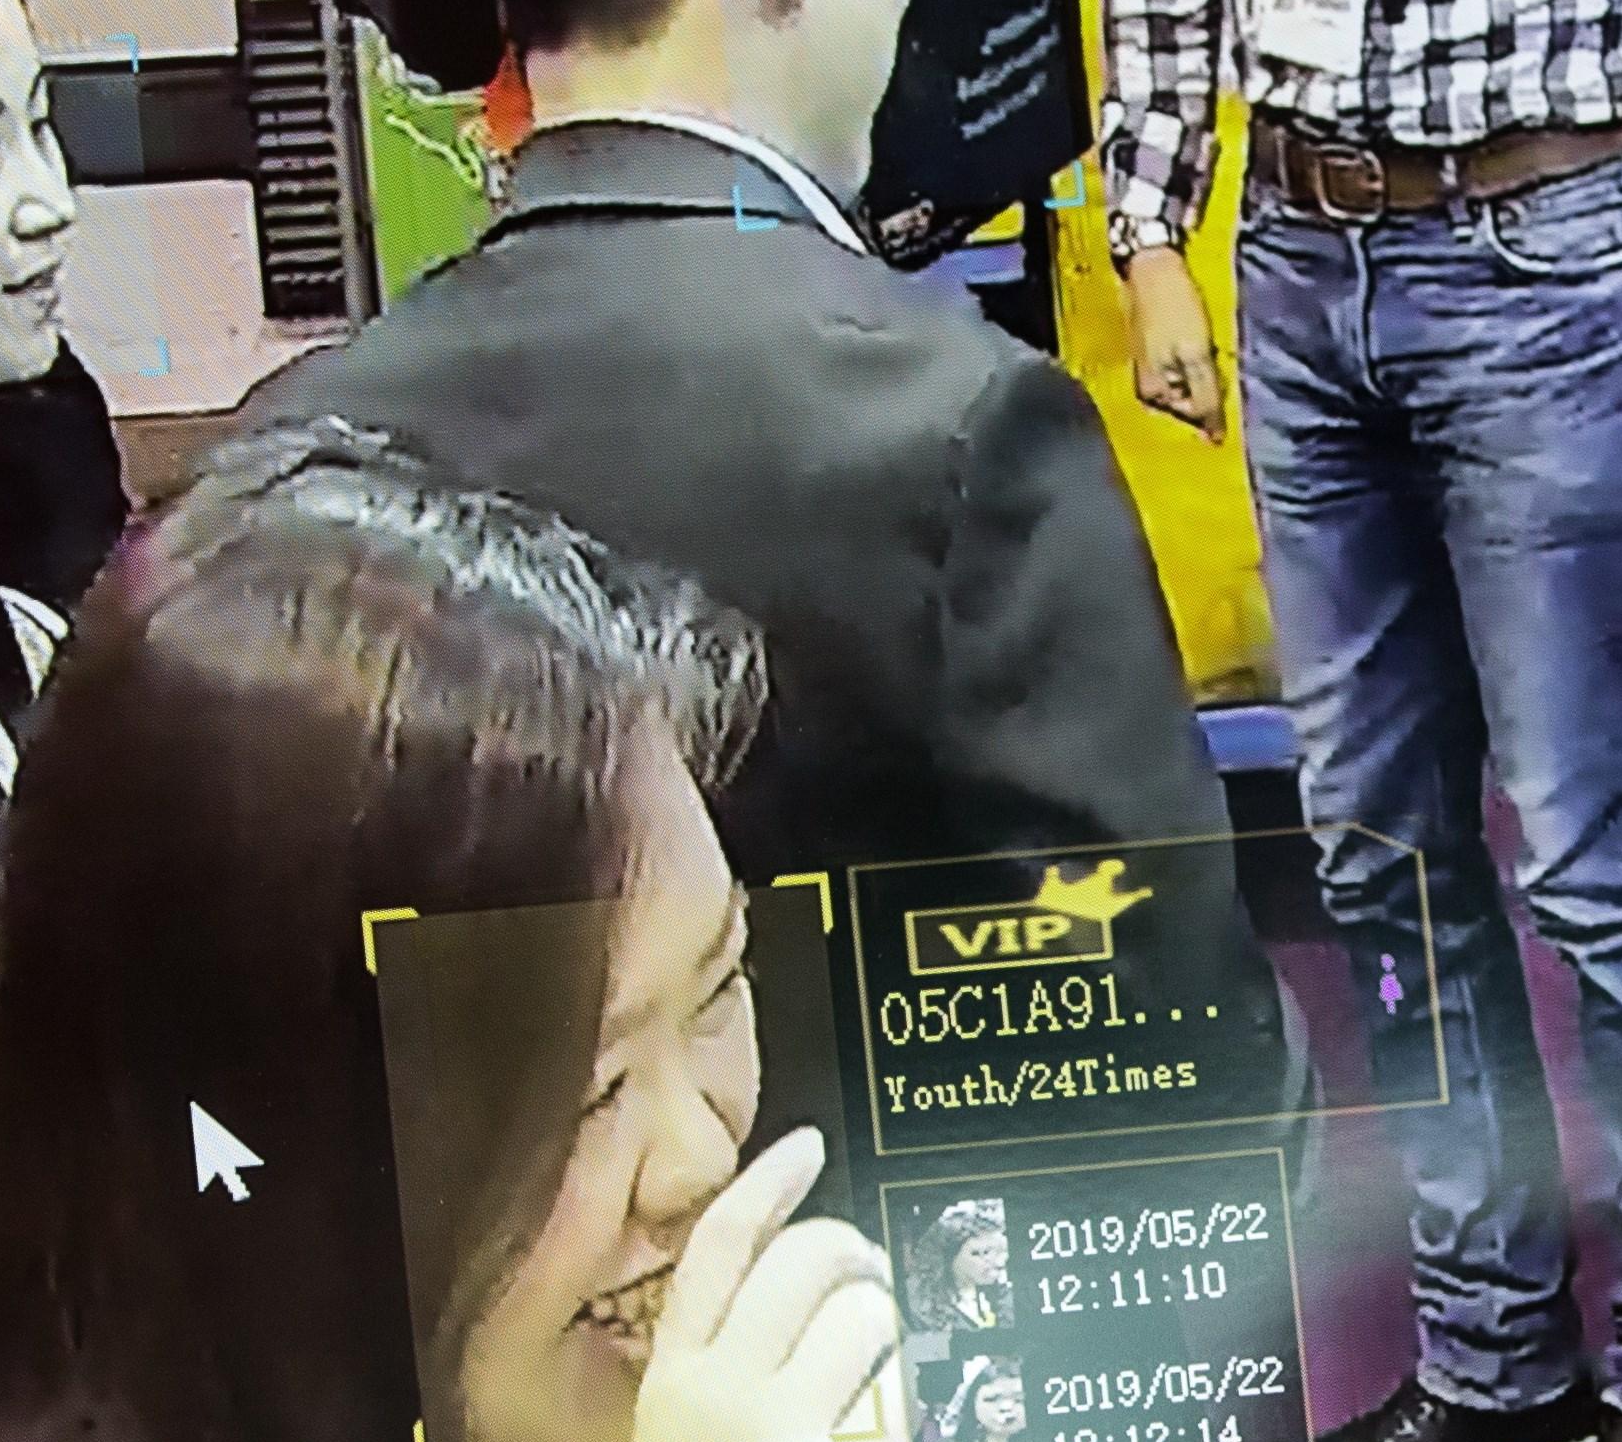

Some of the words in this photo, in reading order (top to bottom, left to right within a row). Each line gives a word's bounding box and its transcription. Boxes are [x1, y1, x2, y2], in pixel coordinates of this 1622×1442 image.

[939, 915, 1072, 958] VIP
[884, 1053, 1197, 1113] Youth/24Times
[1027, 1201, 1270, 1260] 2019/05/22
[1037, 1262, 1228, 1316] 12:11:10
[1044, 1356, 1286, 1417] 2019/05/22
